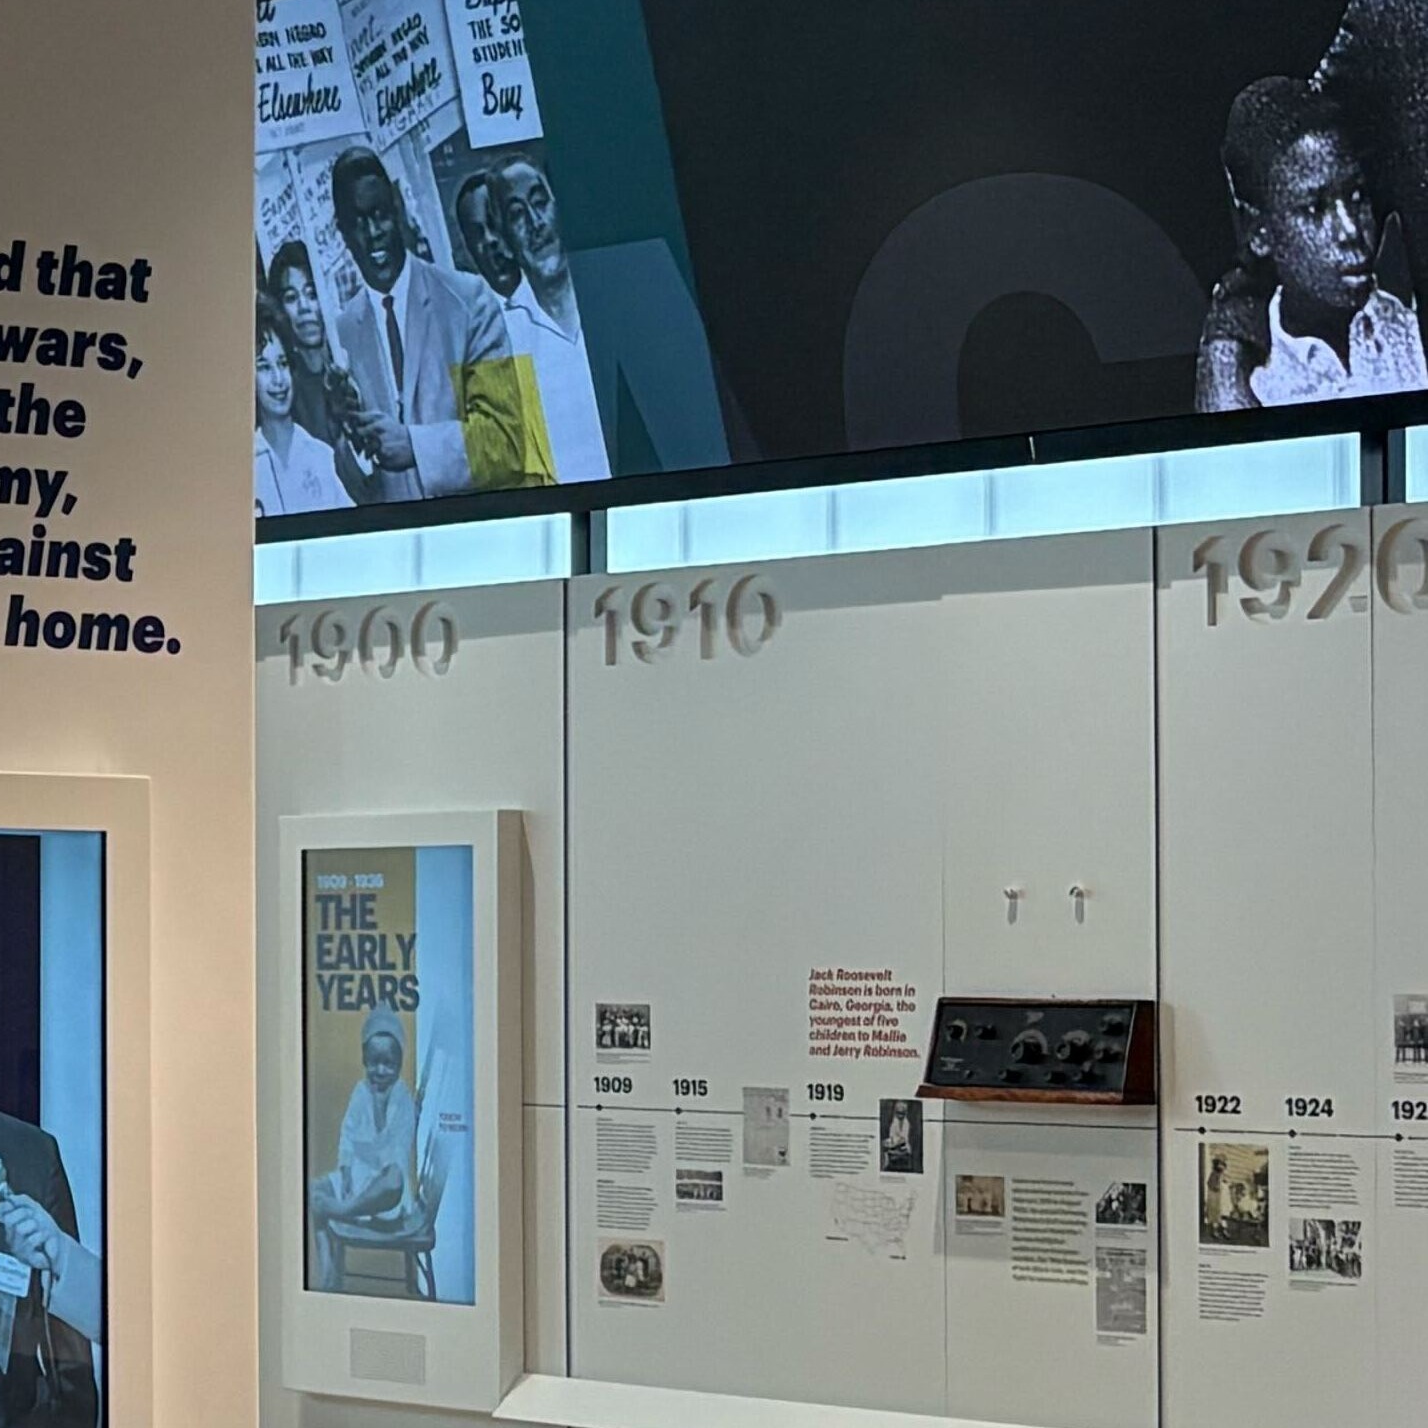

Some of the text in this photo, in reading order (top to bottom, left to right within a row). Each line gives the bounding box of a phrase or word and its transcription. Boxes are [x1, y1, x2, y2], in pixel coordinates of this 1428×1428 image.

[468, 18, 493, 40] THE
[258, 71, 341, 123] Elsewhere
[482, 73, 524, 120] Buy
[37, 246, 152, 302] that
[1193, 517, 1428, 628] 1920
[4, 596, 181, 654] home.
[595, 574, 782, 667] 1910
[280, 600, 459, 686] 1900
[316, 894, 377, 930] THE
[317, 934, 417, 970] EARLY
[809, 969, 892, 981] Jack Roosevelt
[317, 974, 420, 1012] YEARS
[809, 984, 915, 996] Robinson is born in
[897, 1000, 916, 1012] the
[809, 1015, 899, 1028] youngest of five
[809, 1029, 907, 1042] children to Mallie
[809, 1045, 831, 1056] and
[833, 1045, 861, 1059] Jerry
[594, 1077, 633, 1094] 1909
[673, 1079, 708, 1096] 1915
[807, 1083, 844, 1101] 1919
[1195, 1095, 1242, 1114] 1922
[1285, 1098, 1334, 1118] 1924
